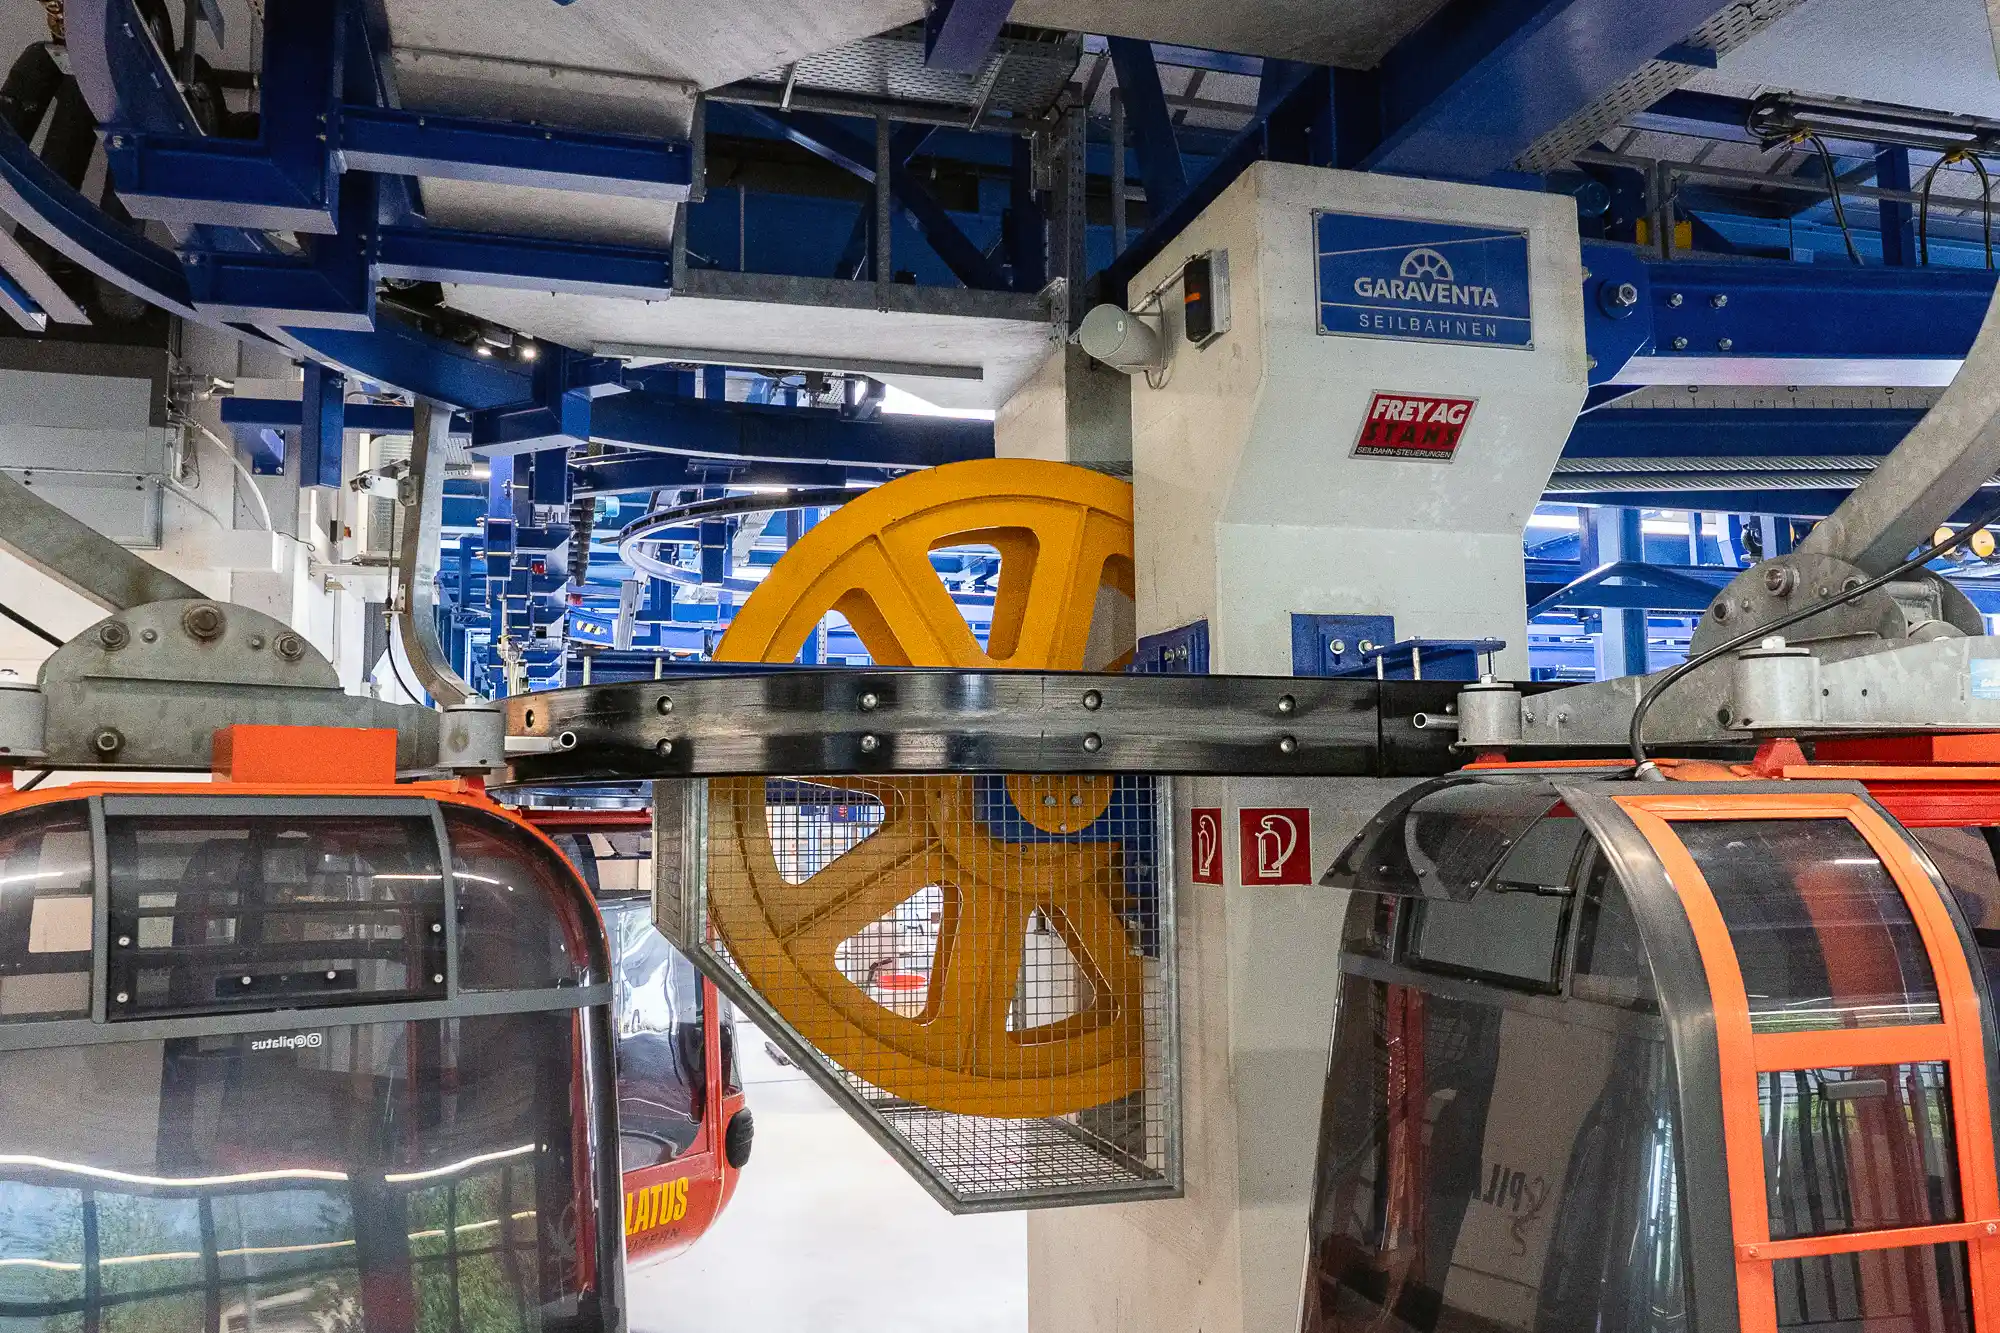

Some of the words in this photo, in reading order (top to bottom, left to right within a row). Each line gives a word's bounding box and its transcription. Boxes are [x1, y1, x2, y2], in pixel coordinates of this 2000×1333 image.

[1354, 277, 1499, 308] GARAVENTA
[1359, 313, 1497, 337] SEILBAHNEN
[1372, 398, 1435, 423] FREY
[1428, 403, 1468, 425] AG
[1366, 421, 1459, 446] STANS
[625, 1176, 689, 1236] LATUS
